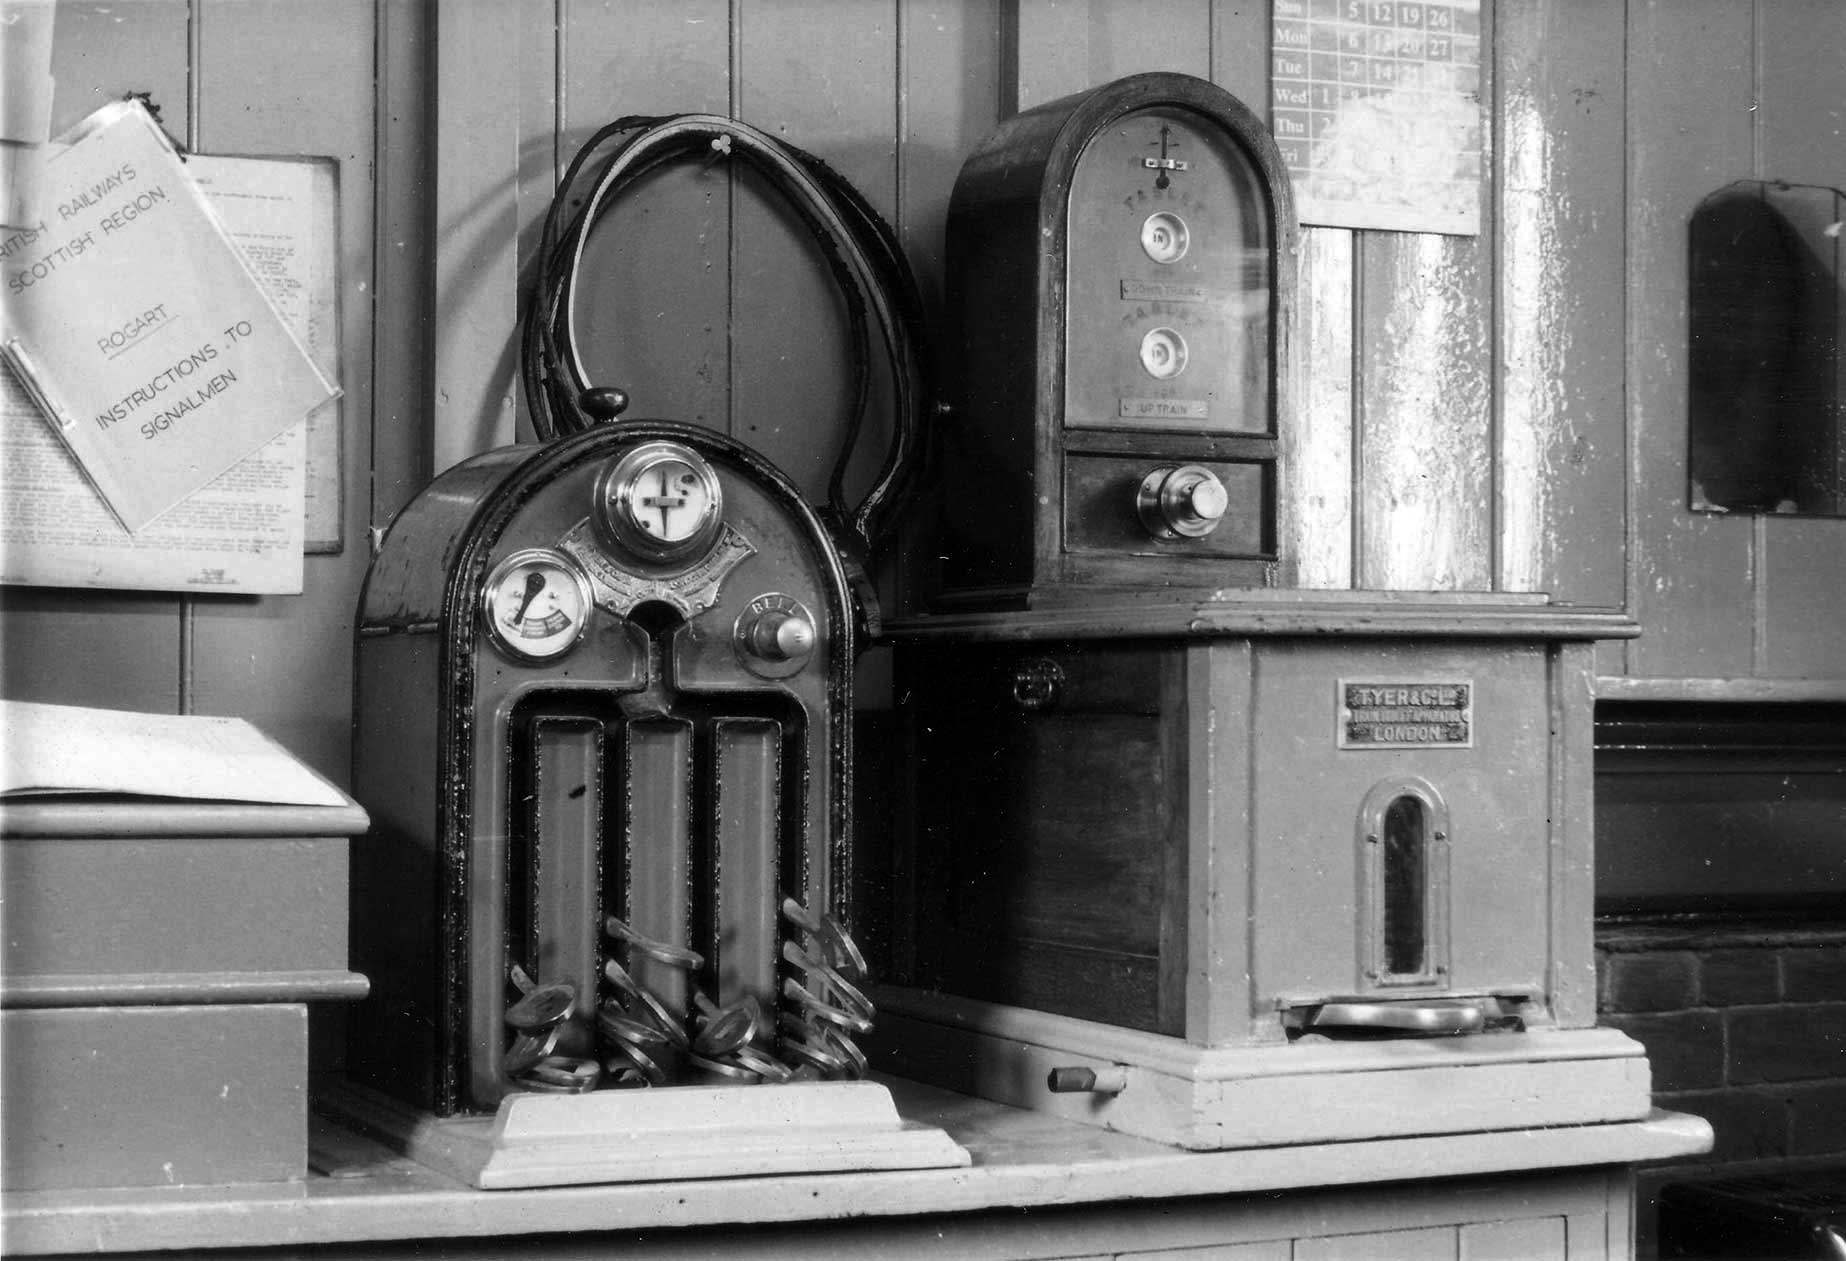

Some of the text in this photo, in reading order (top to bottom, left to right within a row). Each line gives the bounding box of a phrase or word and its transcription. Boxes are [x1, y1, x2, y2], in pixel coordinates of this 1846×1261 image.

[1349, 1, 1358, 18] 5
[1375, 5, 1392, 21] 12
[1403, 7, 1420, 24] 19
[1430, 9, 1448, 27] 26
[1276, 28, 1308, 44] Mon
[1430, 39, 1448, 56] 27
[1276, 59, 1302, 75] Tue
[1275, 87, 1307, 104] Wed
[1276, 117, 1304, 133] Thu
[57, 163, 137, 221] RAILWAYS
[9, 186, 166, 295] SCOTTISH REGION
[97, 304, 168, 354] ROGART
[95, 320, 252, 430] INSTRUCTIONS TO
[140, 368, 238, 440] SIGNALMEN
[1140, 403, 1154, 413] UP
[1374, 726, 1441, 742] LONDON
